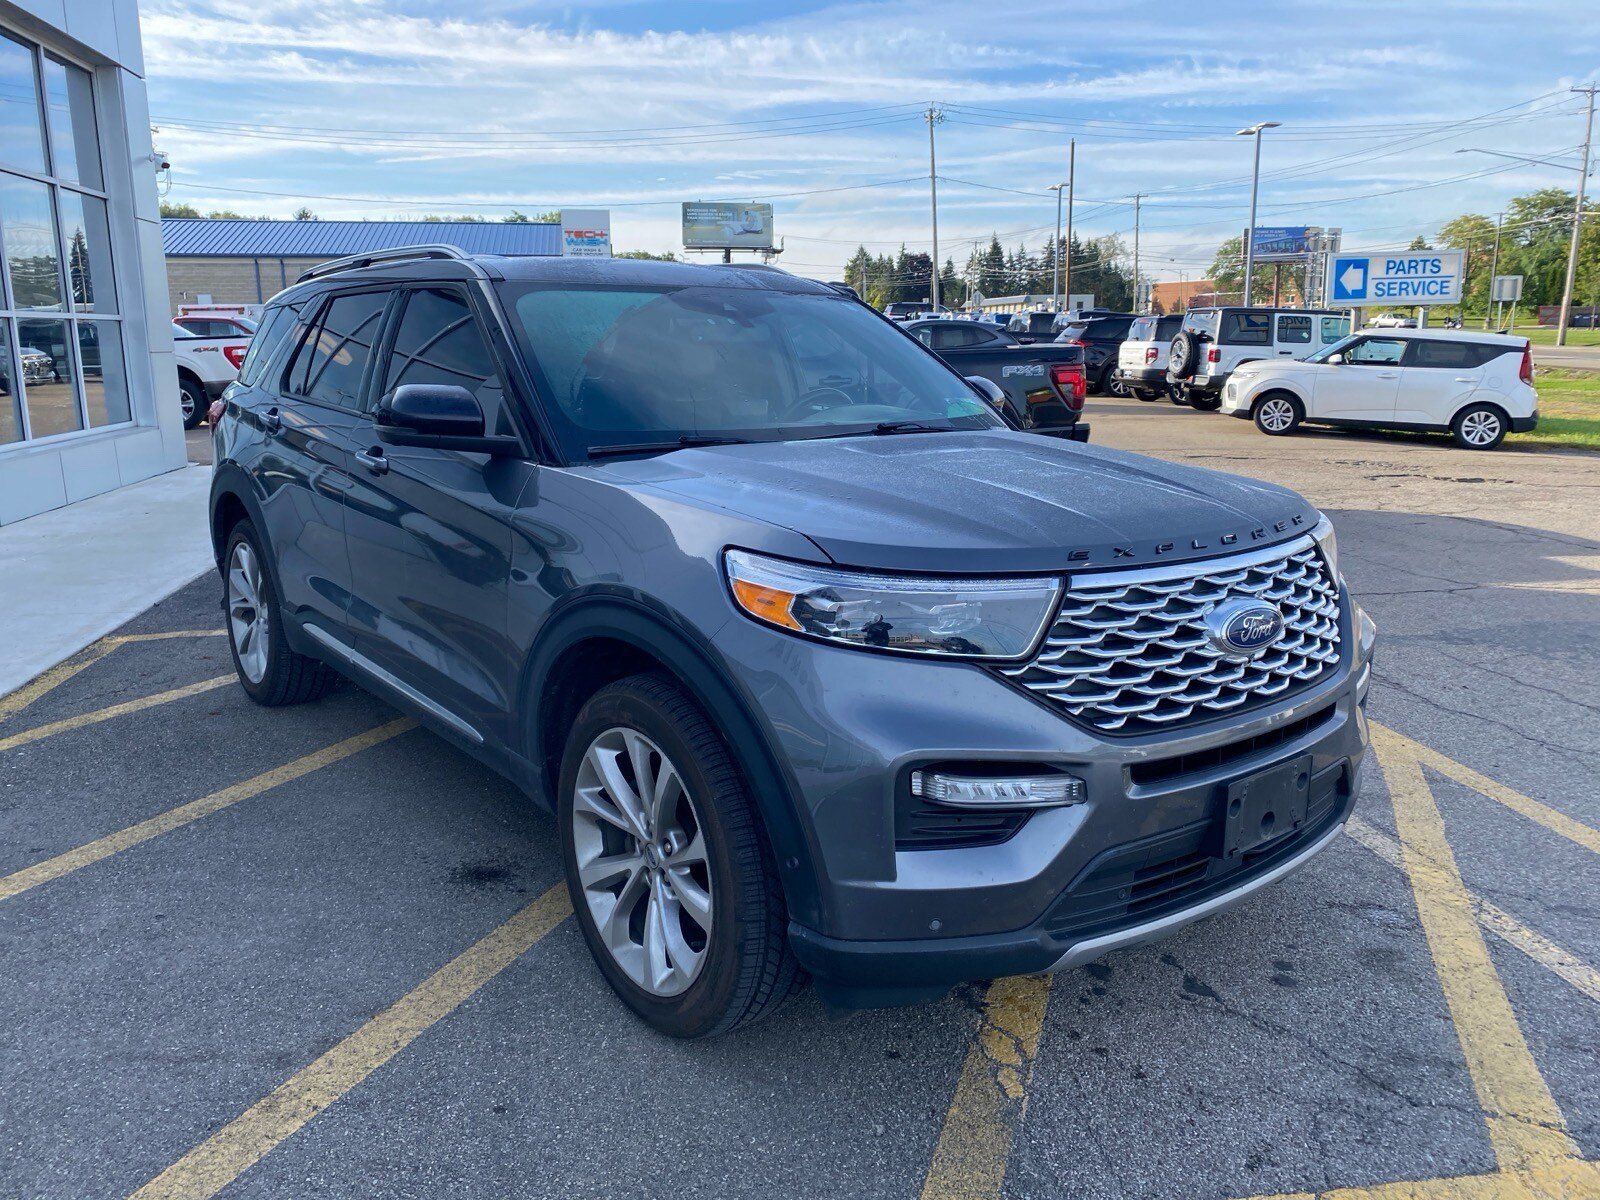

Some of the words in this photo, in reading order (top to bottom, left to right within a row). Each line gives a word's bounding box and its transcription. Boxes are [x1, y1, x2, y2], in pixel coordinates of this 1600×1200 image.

[1385, 259, 1442, 275] PARTS
[1374, 280, 1451, 298] SERVICE
[1002, 364, 1045, 378] FX4
[1067, 514, 1304, 561] EXPLORER
[1240, 614, 1276, 643] Ford
